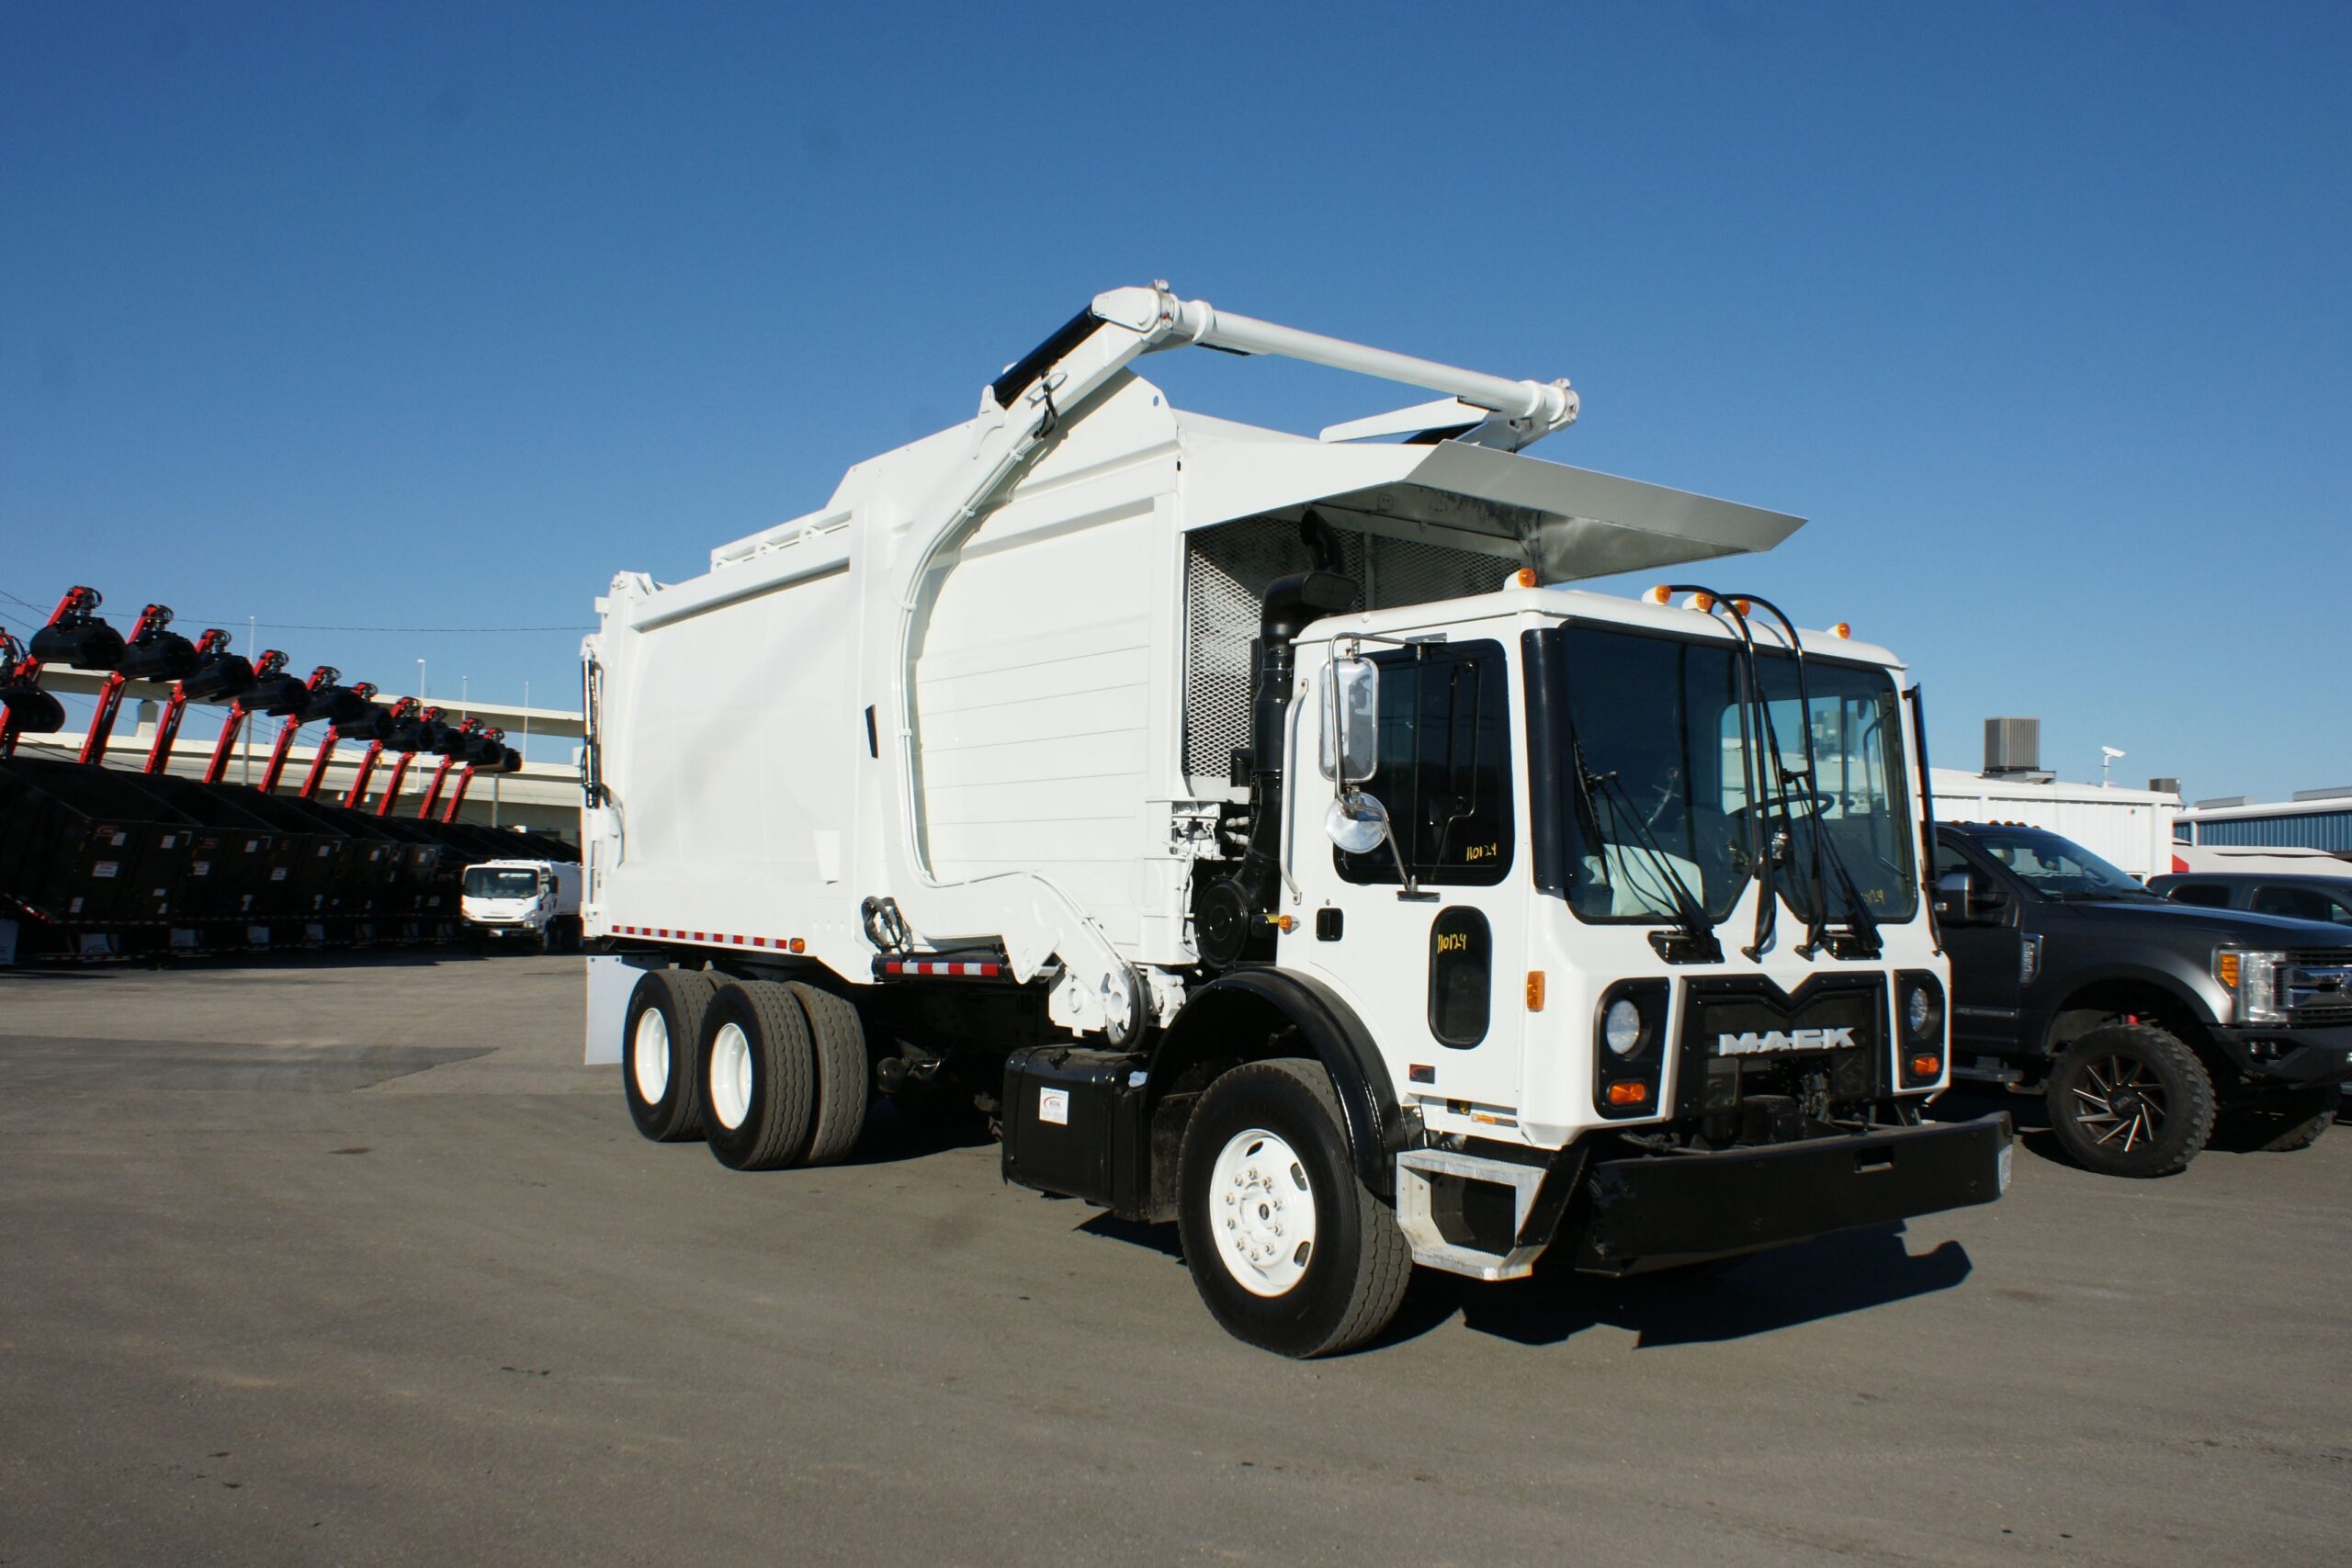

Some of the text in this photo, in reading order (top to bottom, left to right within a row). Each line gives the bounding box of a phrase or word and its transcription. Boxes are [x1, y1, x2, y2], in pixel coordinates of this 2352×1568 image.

[1466, 842, 1497, 862] 110124
[1437, 933, 1467, 954] 110124
[1719, 1027, 1856, 1056] MACK
